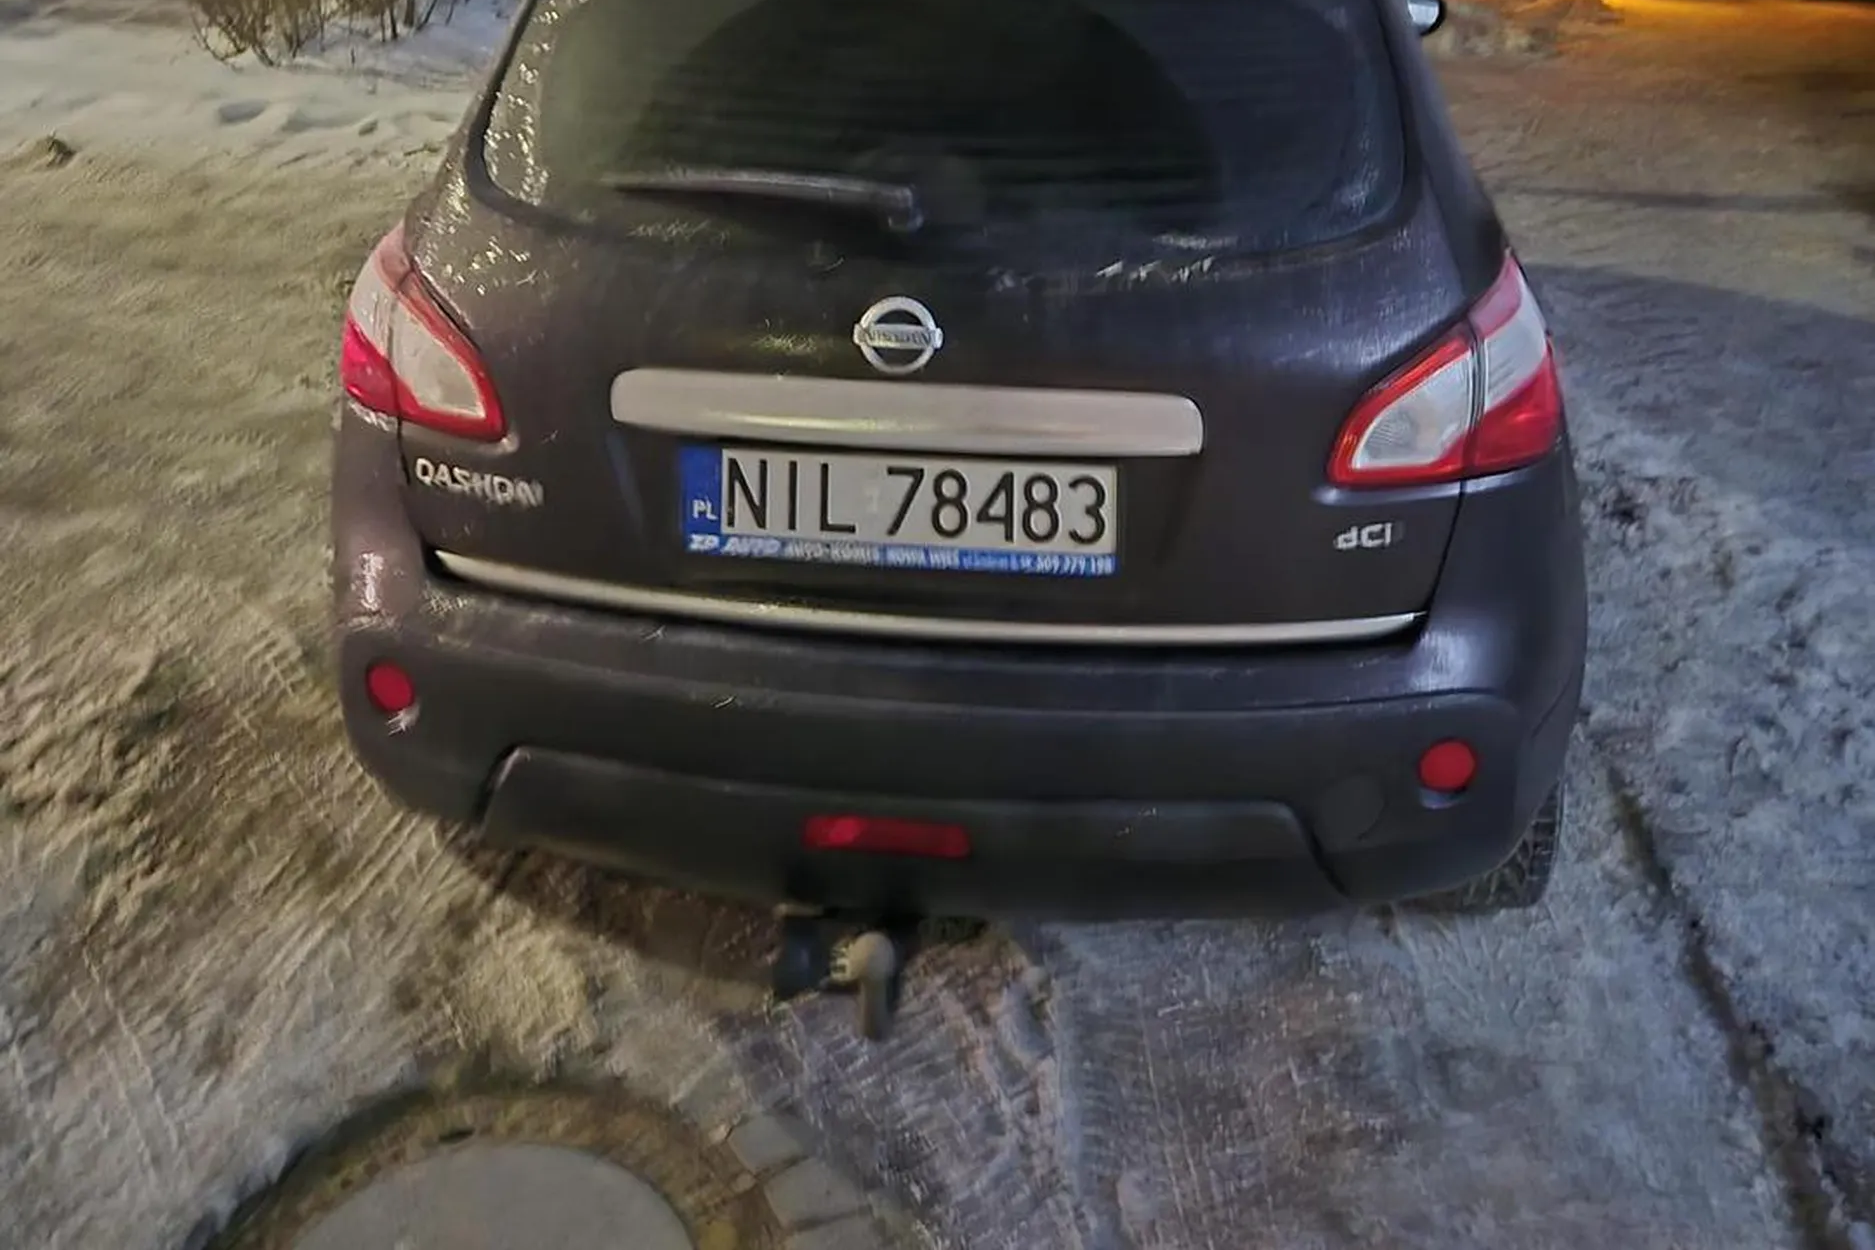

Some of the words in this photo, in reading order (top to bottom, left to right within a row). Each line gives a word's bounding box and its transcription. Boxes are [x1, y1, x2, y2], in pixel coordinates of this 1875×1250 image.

[692, 498, 718, 521] PL
[726, 457, 857, 535] NIL
[886, 466, 1107, 545] 78483
